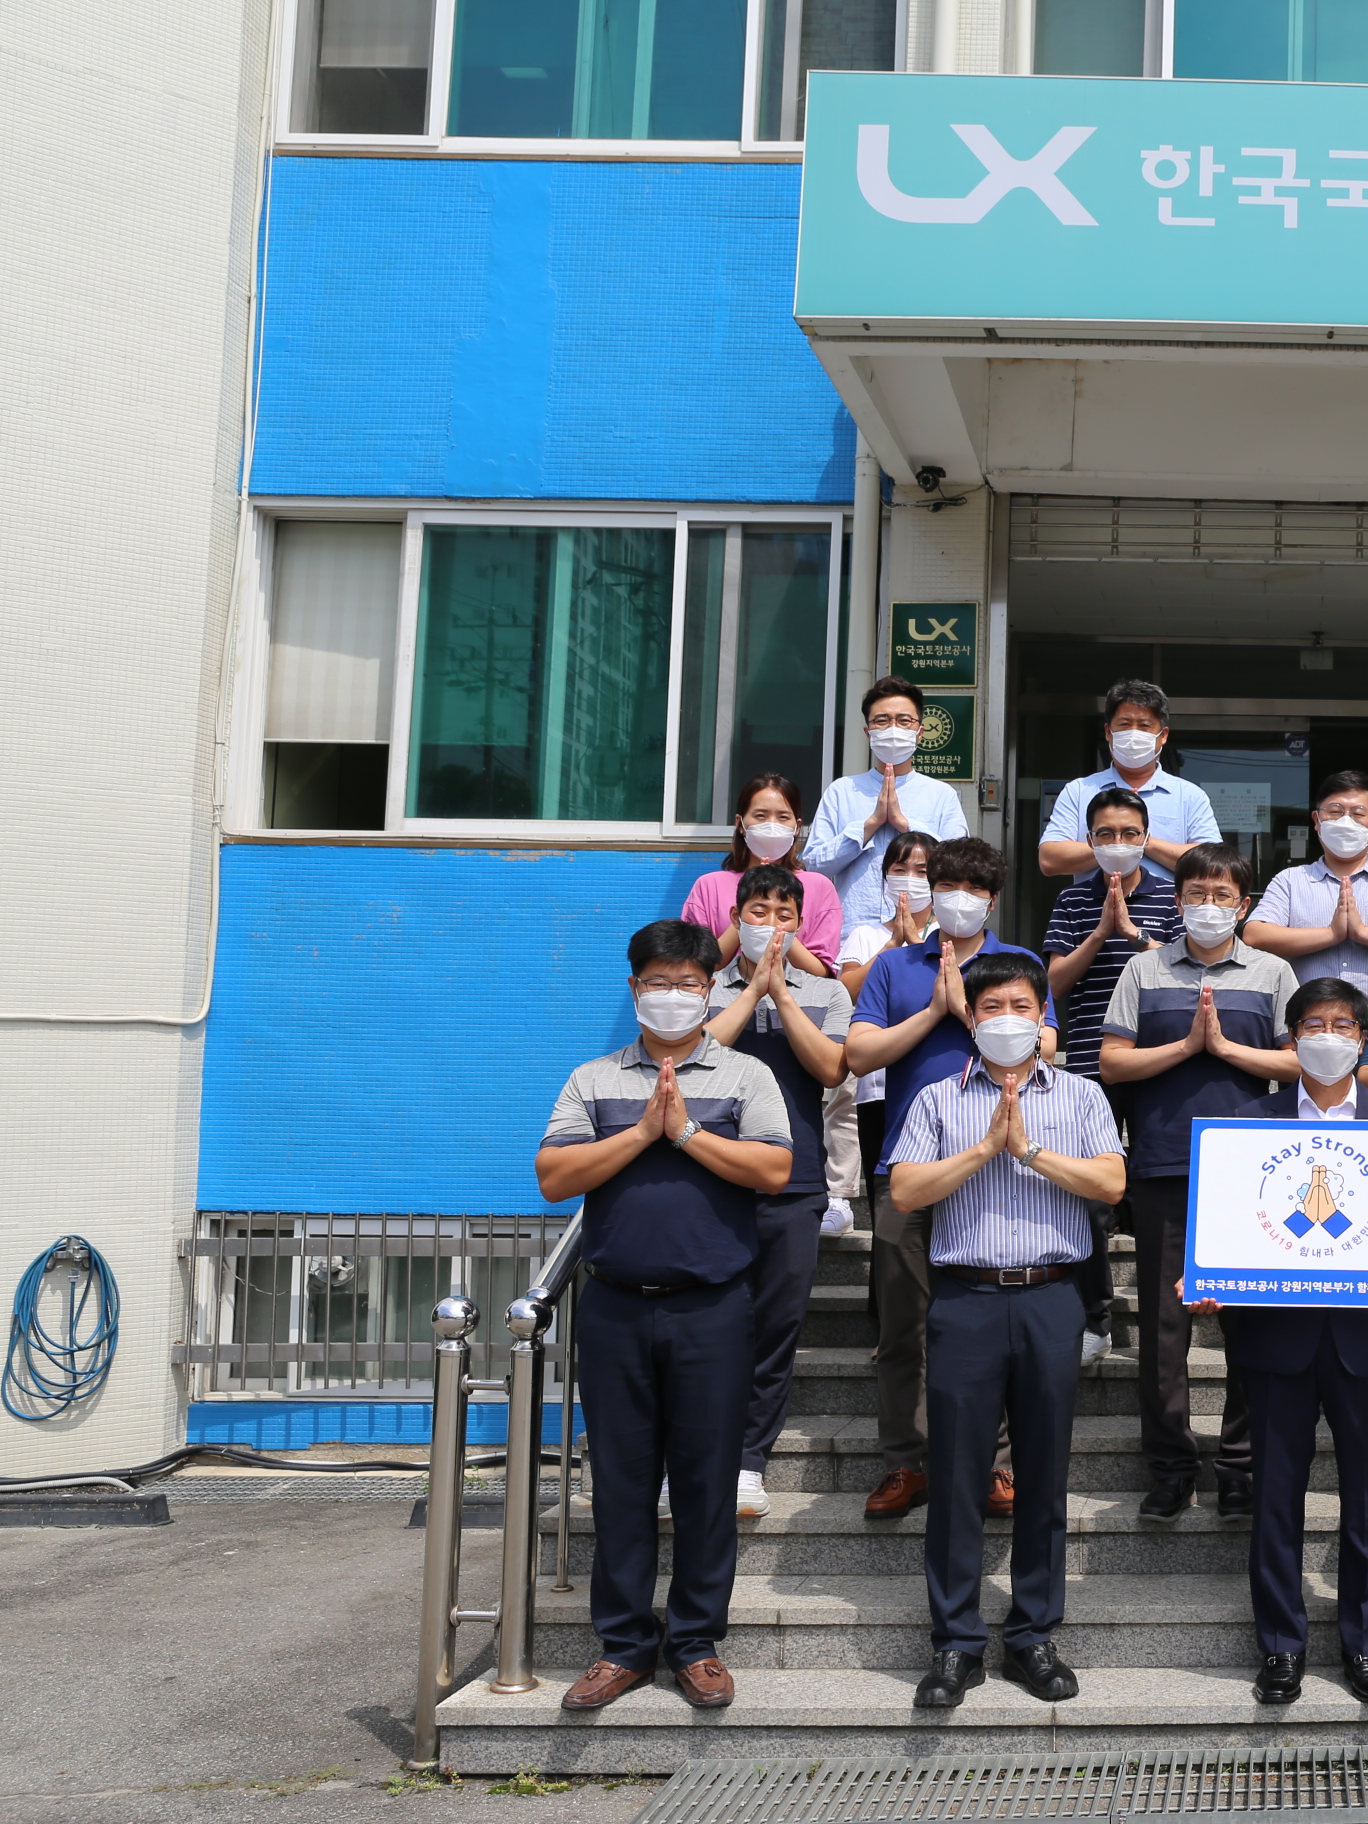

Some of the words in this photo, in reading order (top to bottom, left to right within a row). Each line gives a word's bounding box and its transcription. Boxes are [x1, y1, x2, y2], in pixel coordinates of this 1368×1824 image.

[856, 124, 1100, 226] LX
[908, 618, 959, 641] LX
[895, 645, 971, 656] 한국국토정보공사
[911, 659, 954, 668] 강원지역본부
[1289, 740, 1305, 749] ADT
[911, 755, 961, 765] 국토정보공사
[1261, 1141, 1302, 1175] Stay
[1256, 1210, 1293, 1251] 코로나19
[1299, 1245, 1335, 1258] 힘내라
[1195, 1279, 1279, 1292] 한국국토정보공사
[1281, 1280, 1355, 1294] 강원지역본부가
